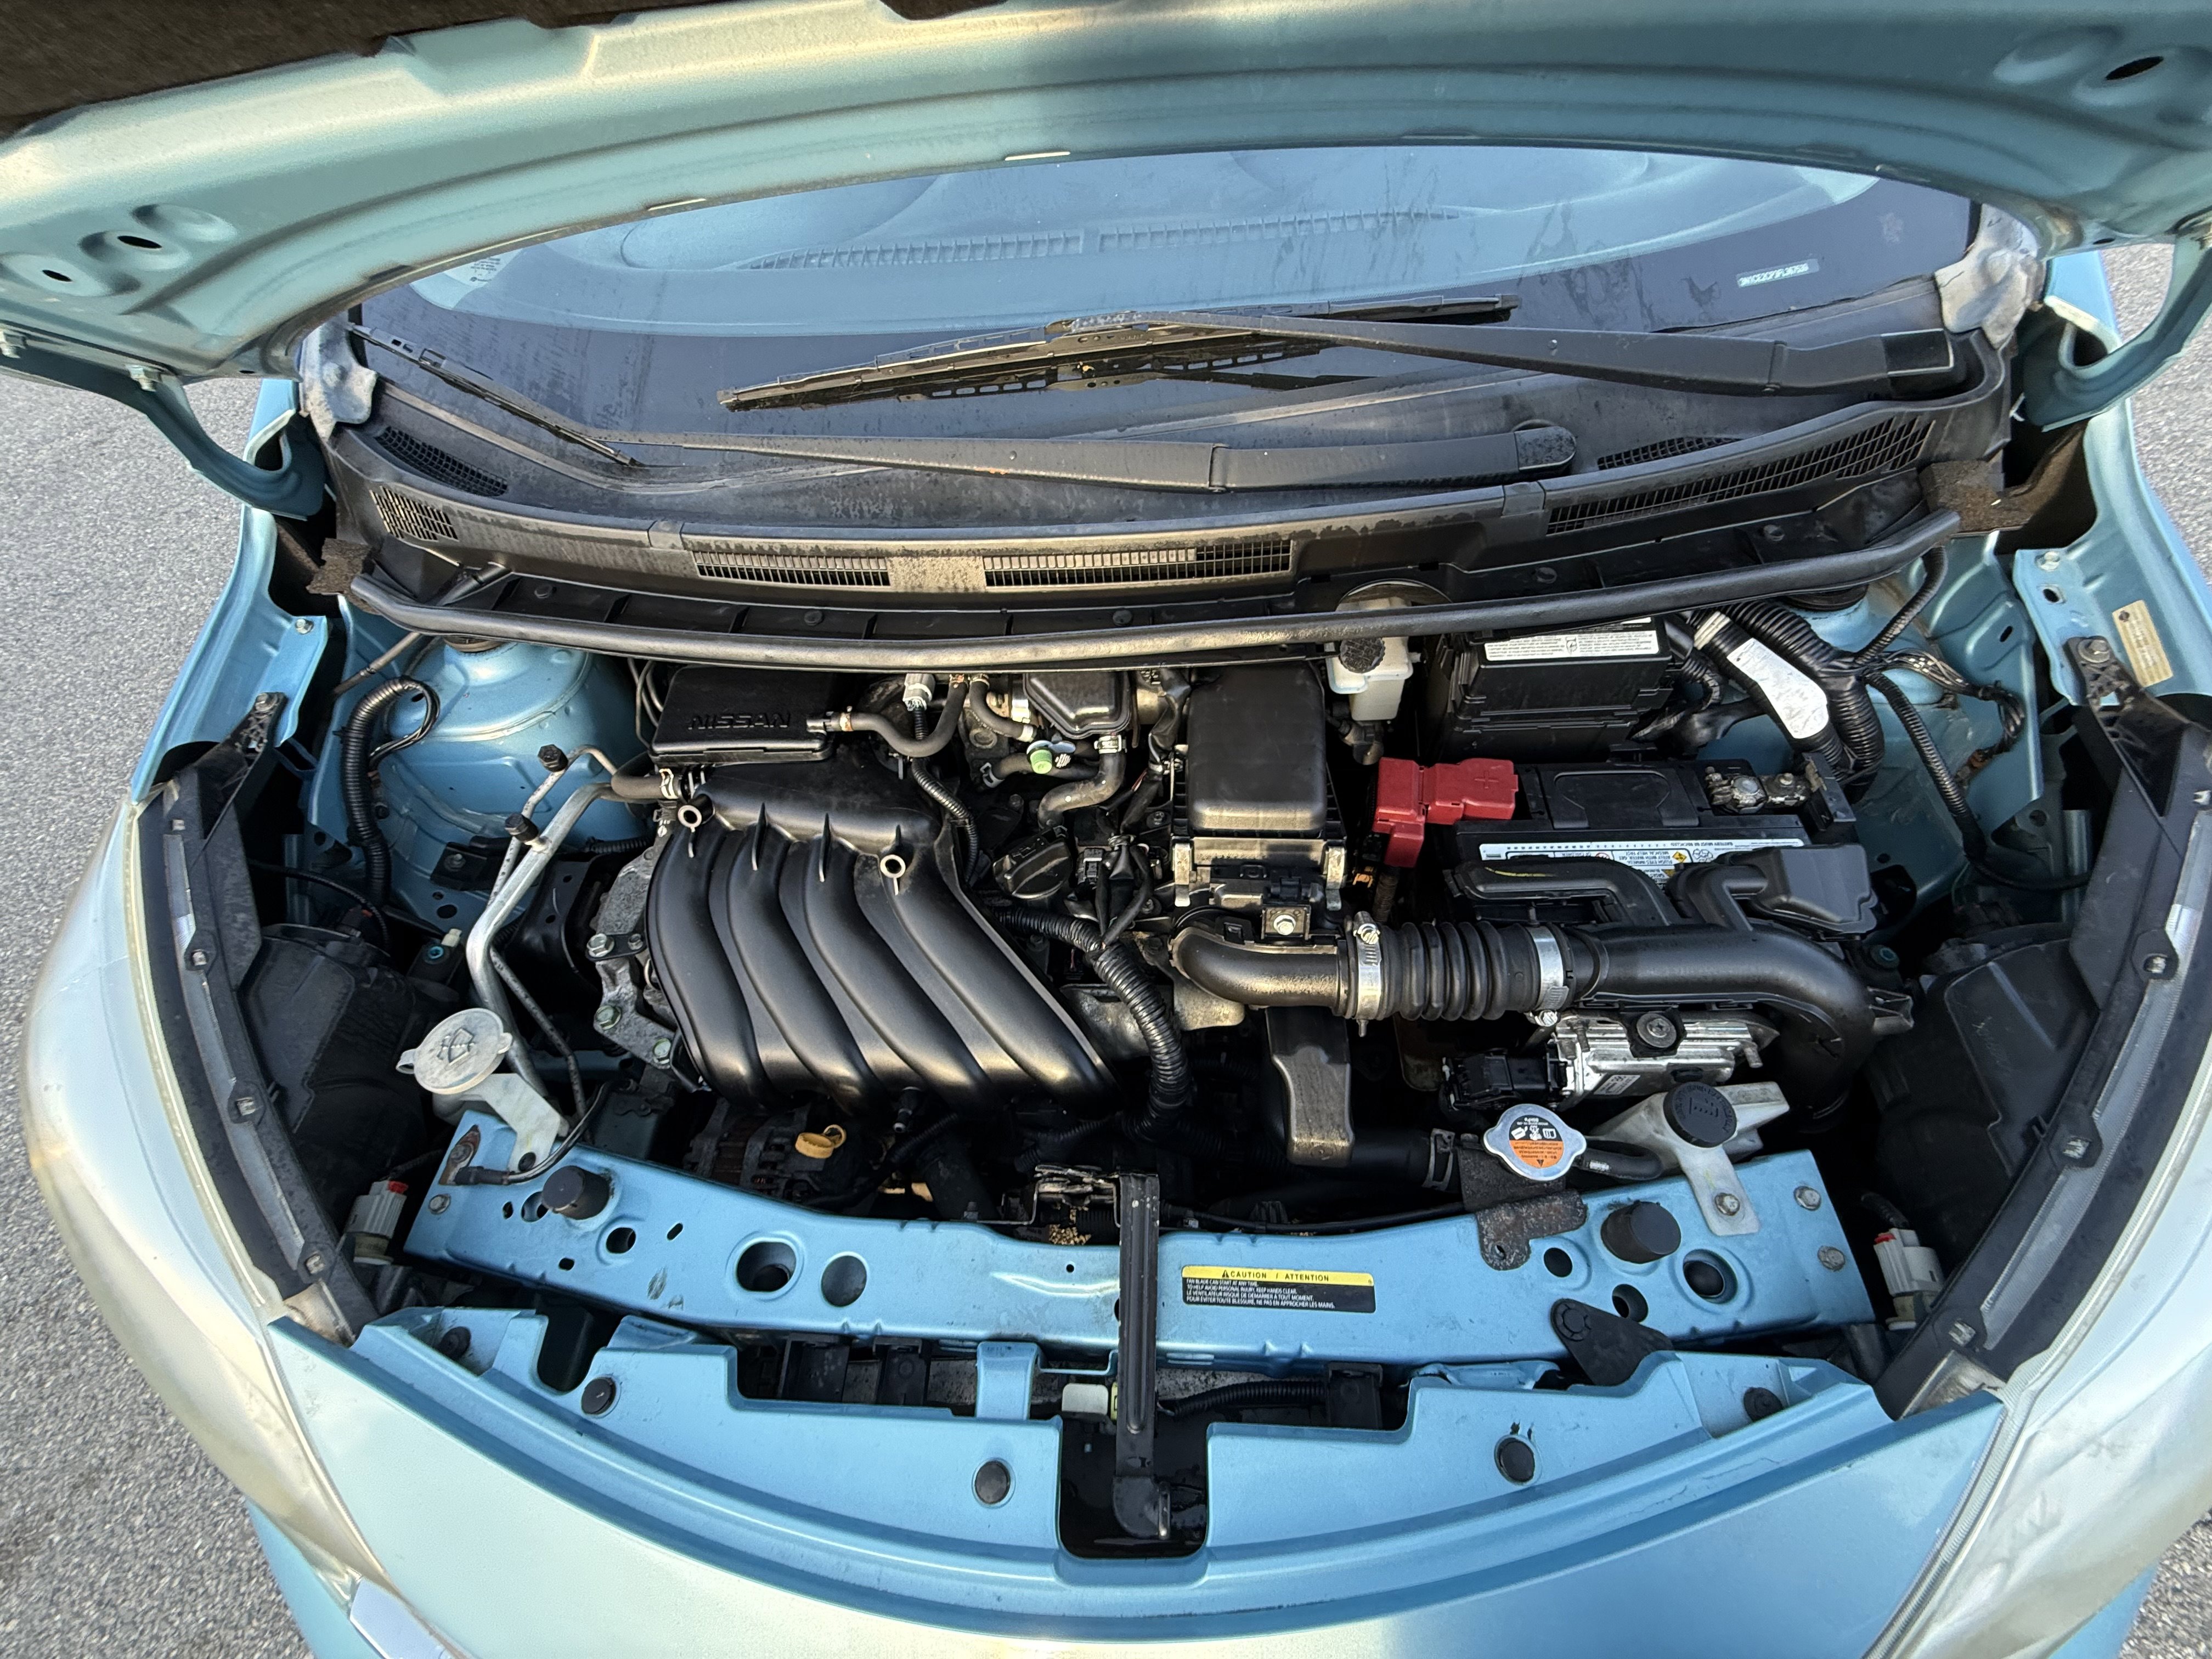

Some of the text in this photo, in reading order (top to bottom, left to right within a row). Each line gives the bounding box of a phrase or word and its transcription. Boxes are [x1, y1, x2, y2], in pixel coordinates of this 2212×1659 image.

[687, 713, 791, 730] NISSAN
[1230, 1271, 1267, 1279] CAUTION
[1285, 1273, 1329, 1282] ATTENTION
